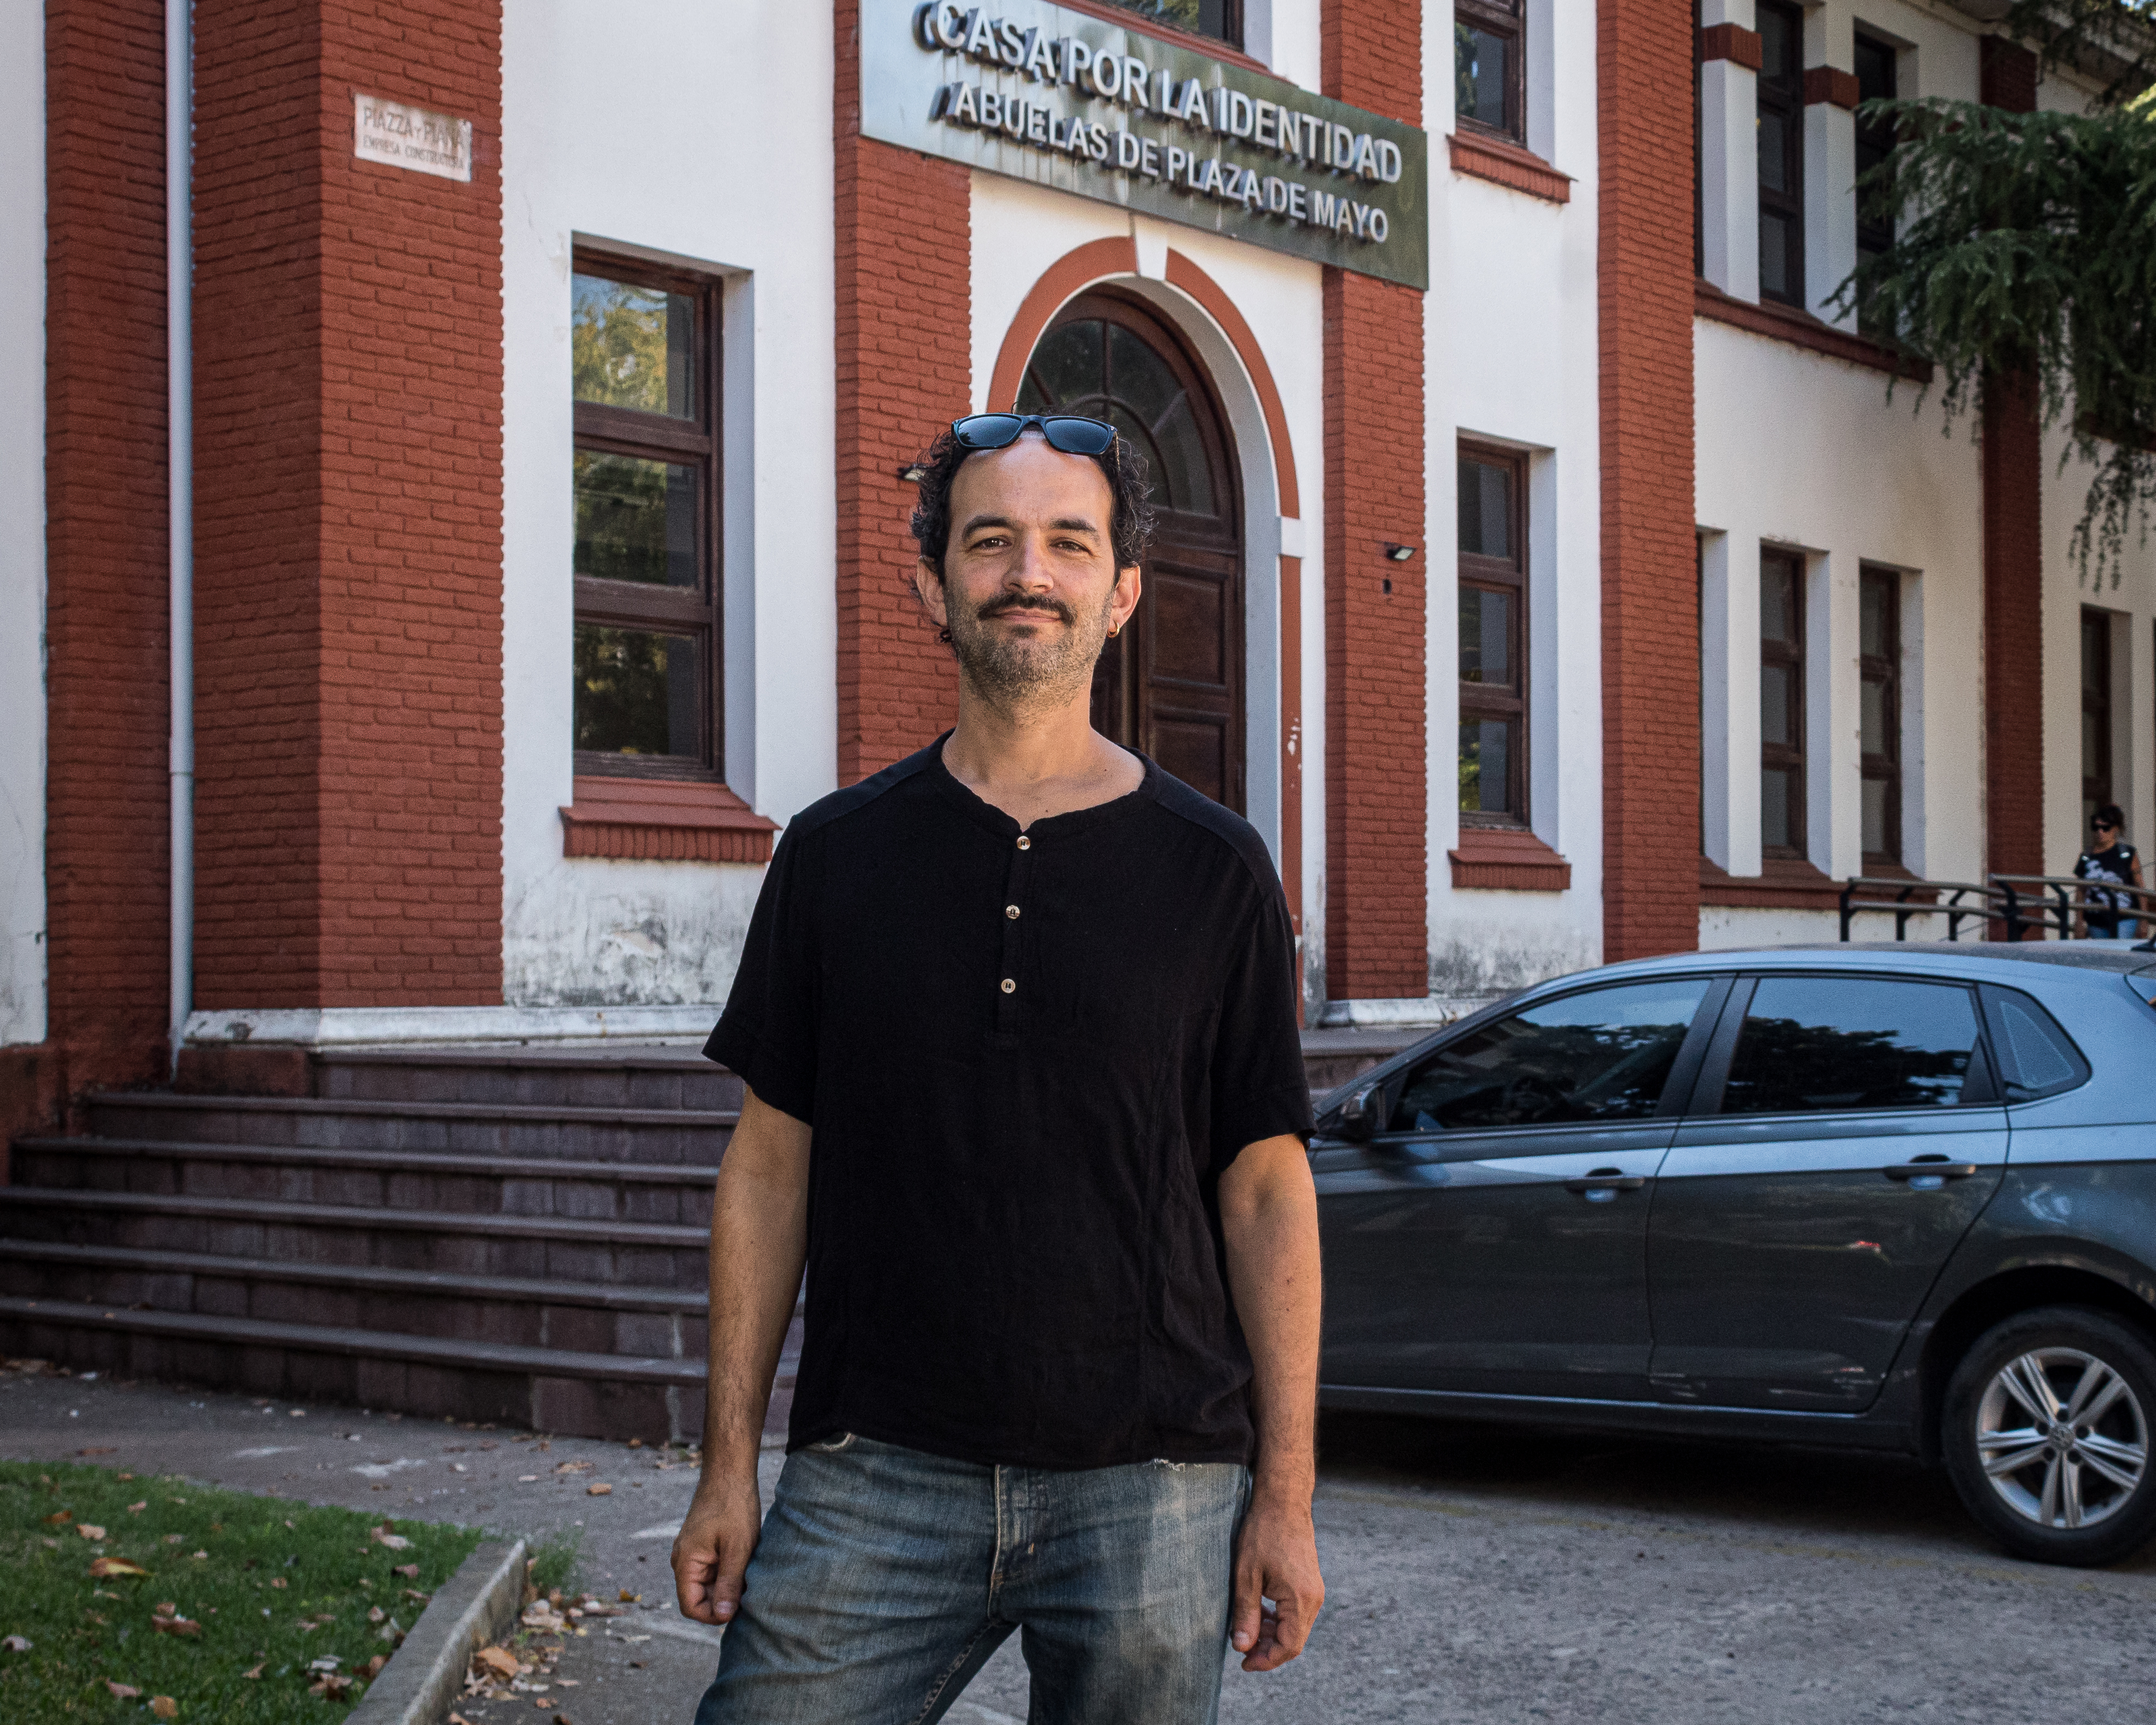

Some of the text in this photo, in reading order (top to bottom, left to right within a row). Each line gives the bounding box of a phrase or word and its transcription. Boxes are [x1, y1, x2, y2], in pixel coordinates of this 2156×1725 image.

[363, 106, 413, 138] PIAZZA
[935, 0, 1402, 184] CASA POR LA IDENTIDAD
[953, 81, 1389, 243] ABUELAS DE PLAZA DE MAYO
